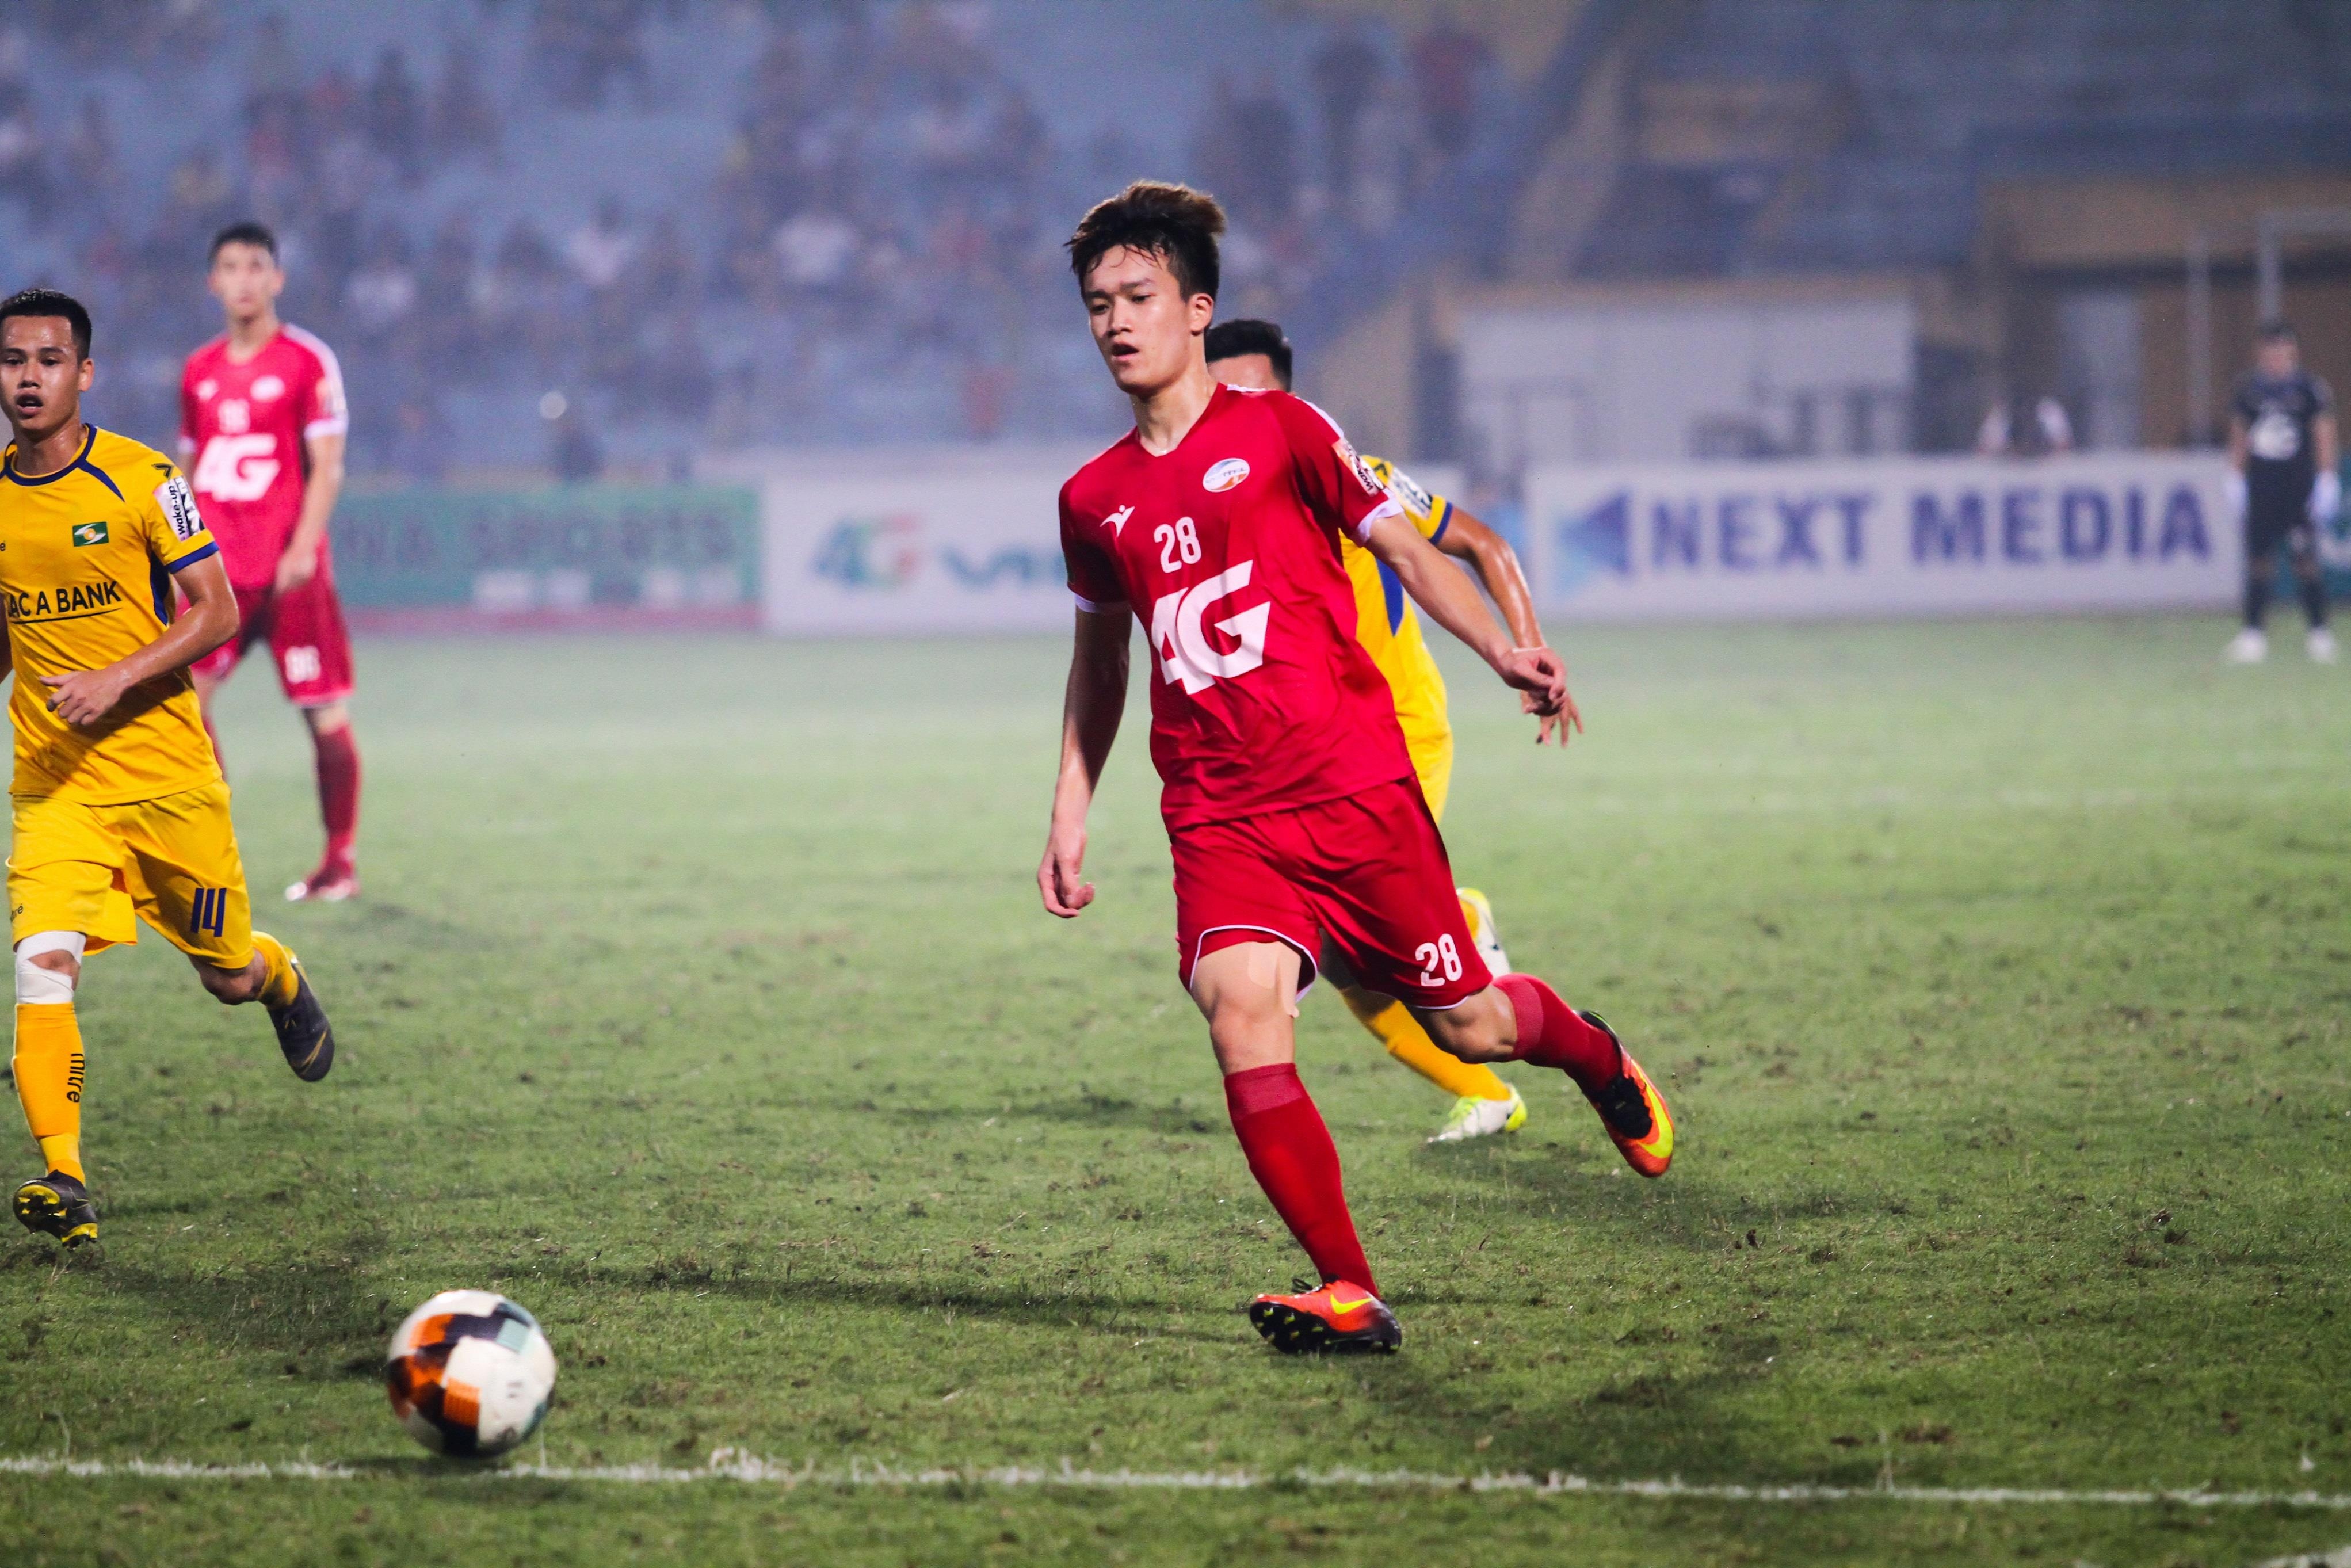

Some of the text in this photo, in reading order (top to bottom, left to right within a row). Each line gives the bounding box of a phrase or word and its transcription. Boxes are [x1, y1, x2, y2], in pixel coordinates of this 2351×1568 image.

[193, 432, 282, 502] 4G
[169, 486, 186, 535] wake-up
[1649, 488, 1880, 571] NEXT
[1909, 482, 2215, 566] MEDIA
[1154, 516, 1202, 574] 28
[8, 581, 122, 617] AC A BANK
[1151, 559, 1271, 695] 4G
[1415, 933, 1463, 987] 28
[66, 1053, 85, 1104] mitre
